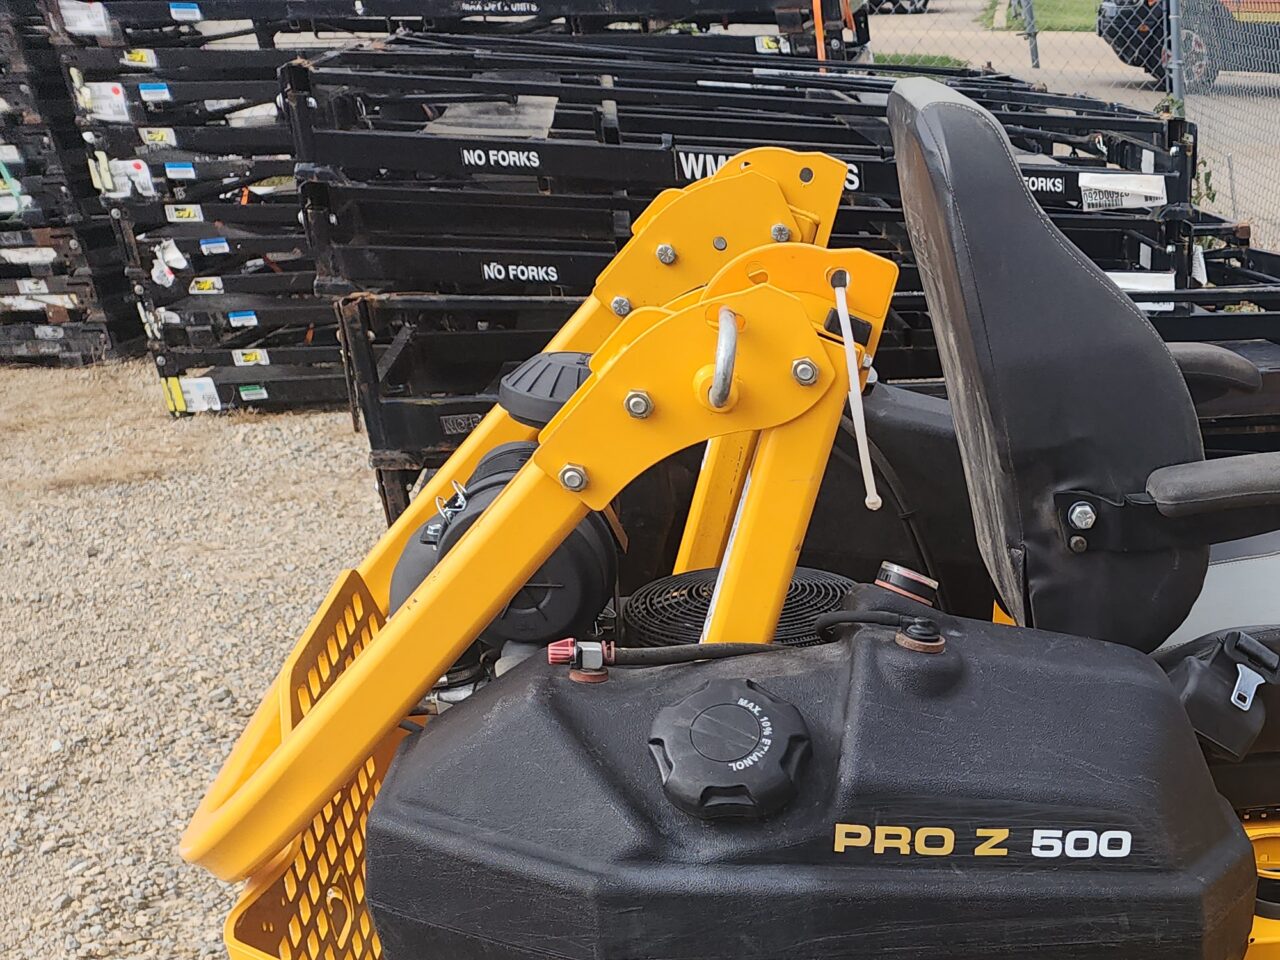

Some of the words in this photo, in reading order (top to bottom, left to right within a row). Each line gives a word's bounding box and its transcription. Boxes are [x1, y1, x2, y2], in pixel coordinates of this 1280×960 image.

[463, 149, 486, 166] NO
[488, 150, 540, 168] FORKS
[483, 262, 506, 280] NO
[508, 265, 558, 281] FORKS
[737, 697, 763, 716] MAX.
[759, 716, 773, 736] 10%
[728, 737, 772, 771] ETHANOL
[834, 823, 955, 856] PRO
[974, 828, 1010, 856] Z
[1031, 829, 1132, 858] 500
